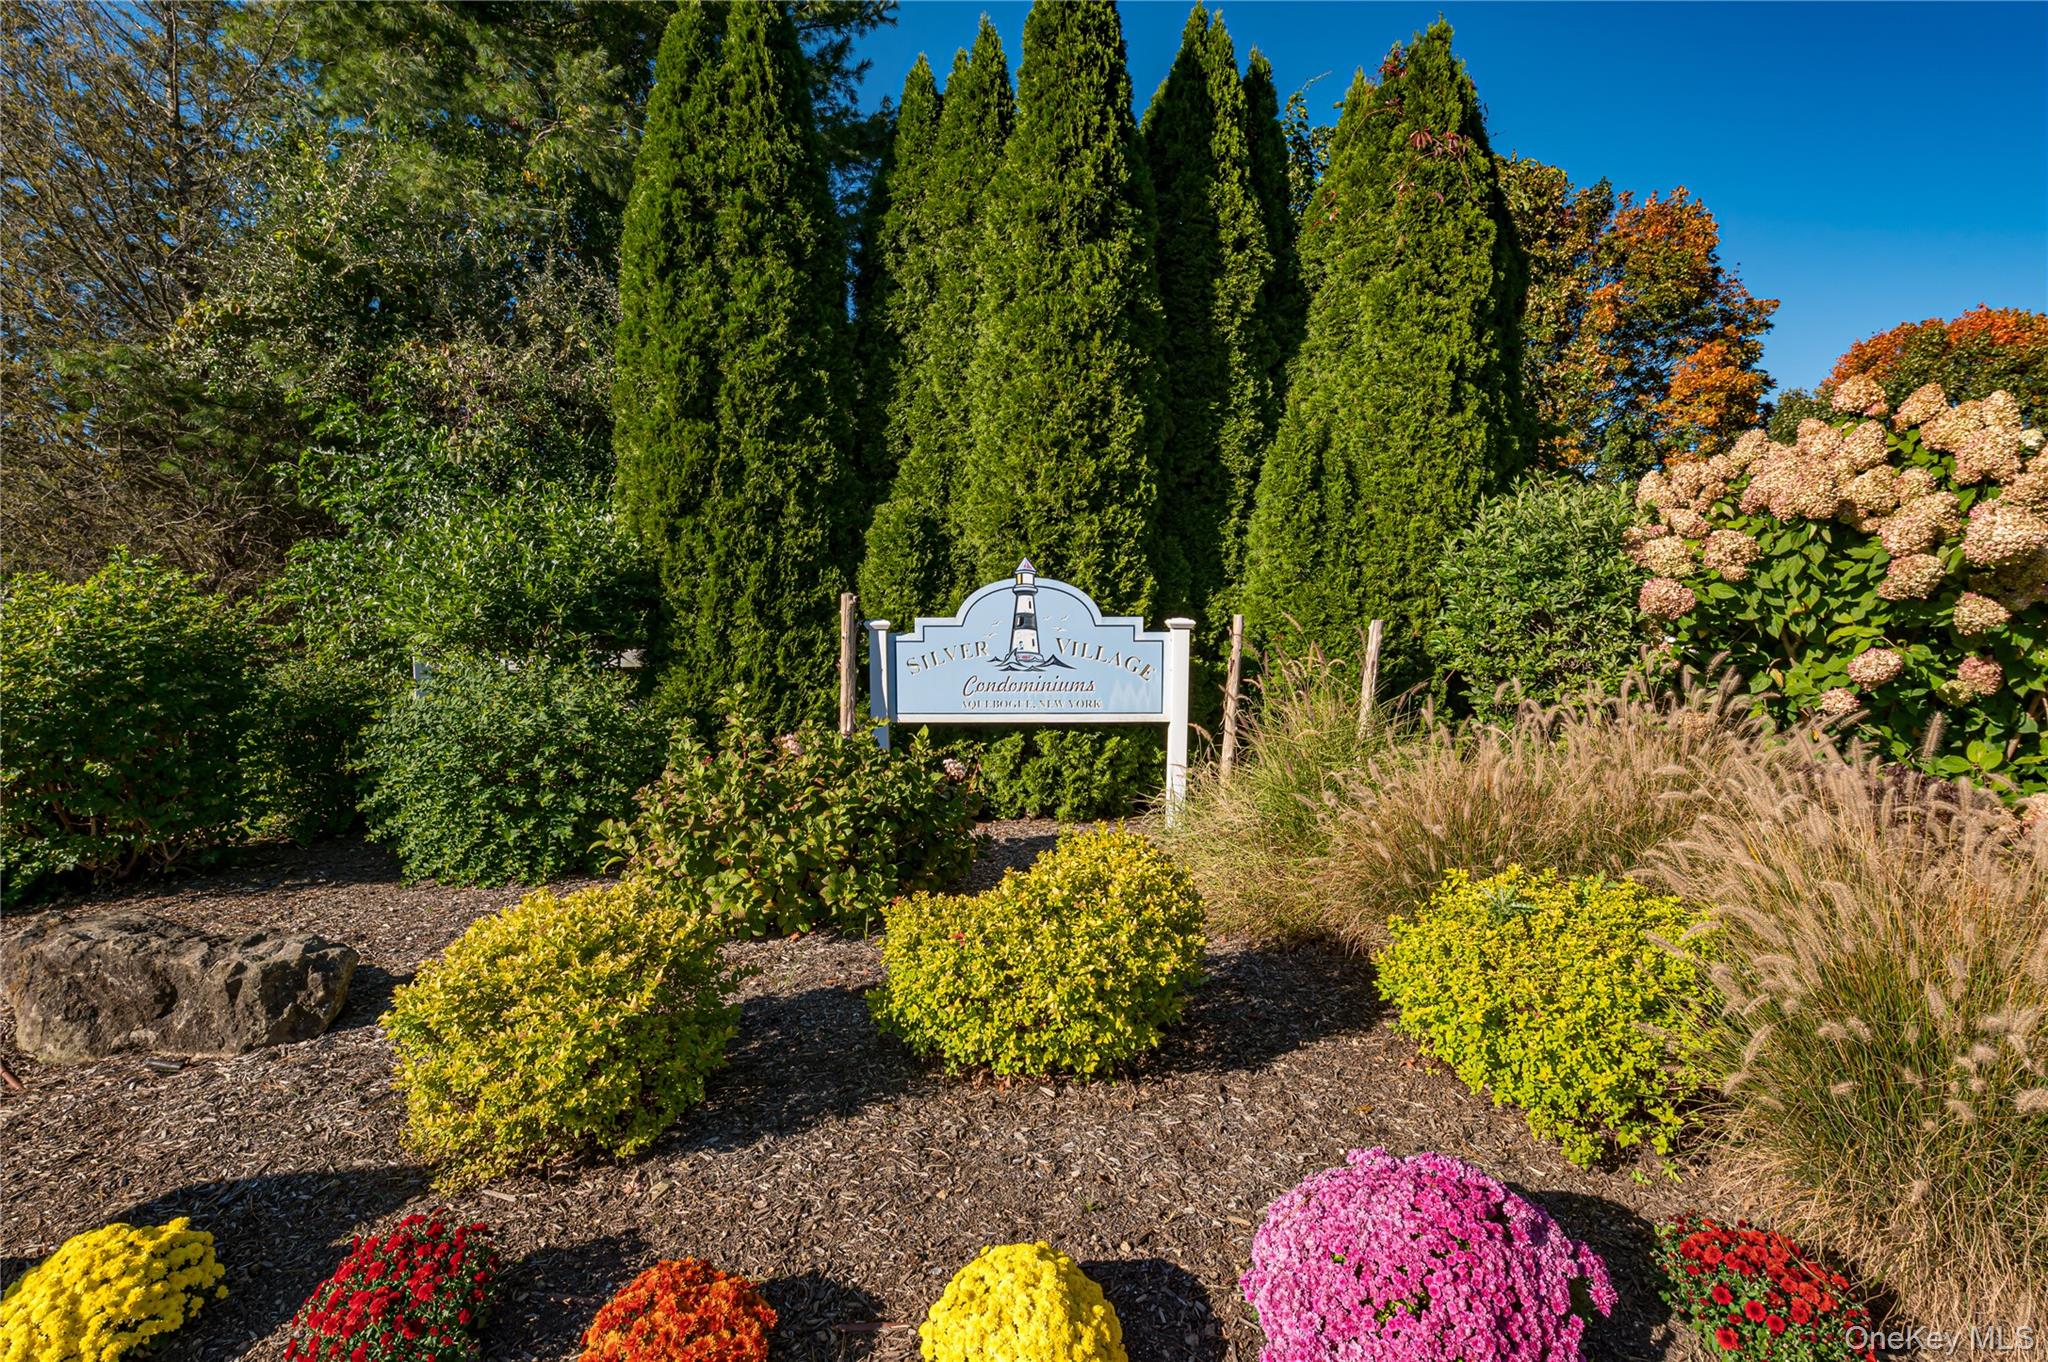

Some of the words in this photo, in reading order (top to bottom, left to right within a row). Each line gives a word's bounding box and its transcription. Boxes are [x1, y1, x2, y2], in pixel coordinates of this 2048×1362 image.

[906, 640, 989, 676] SILVER
[1056, 637, 1156, 682] VILLAGE
[962, 674, 1096, 697] Condominiums
[1039, 699, 1064, 709] NEW
[1068, 699, 1102, 709] YORK
